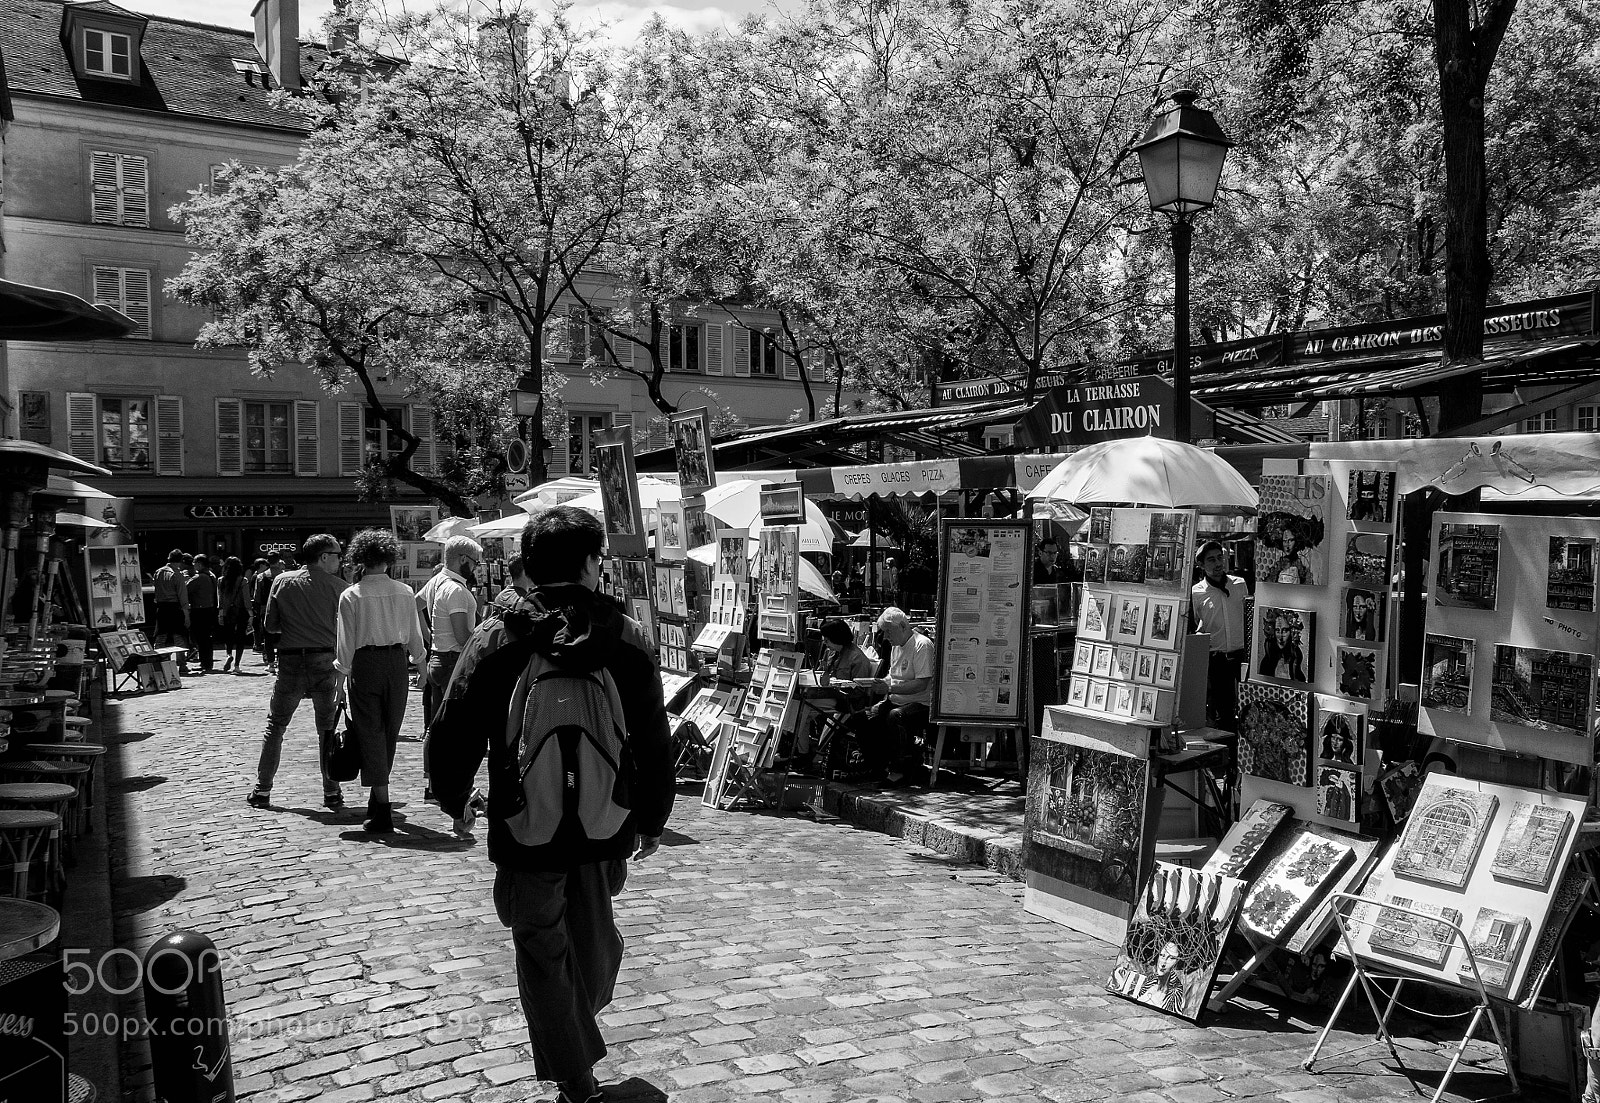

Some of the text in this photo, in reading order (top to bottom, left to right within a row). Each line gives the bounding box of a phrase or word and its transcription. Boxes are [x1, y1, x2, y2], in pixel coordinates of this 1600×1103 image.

[1304, 339, 1325, 356] AU
[1331, 330, 1401, 352] CLAIRON
[1410, 325, 1444, 344] DES
[1221, 347, 1259, 364] PIZZA
[942, 387, 952, 401] AU
[955, 383, 990, 399] CLAIRON
[994, 381, 1010, 395] DES
[1067, 382, 1141, 404] LA TERRASSE
[1050, 403, 1162, 435] DU CLAIRON
[844, 473, 871, 485] CREPES
[881, 470, 910, 483] GLACES
[922, 468, 944, 481] PIZZA
[1557, 623, 1582, 638] PHOTO
